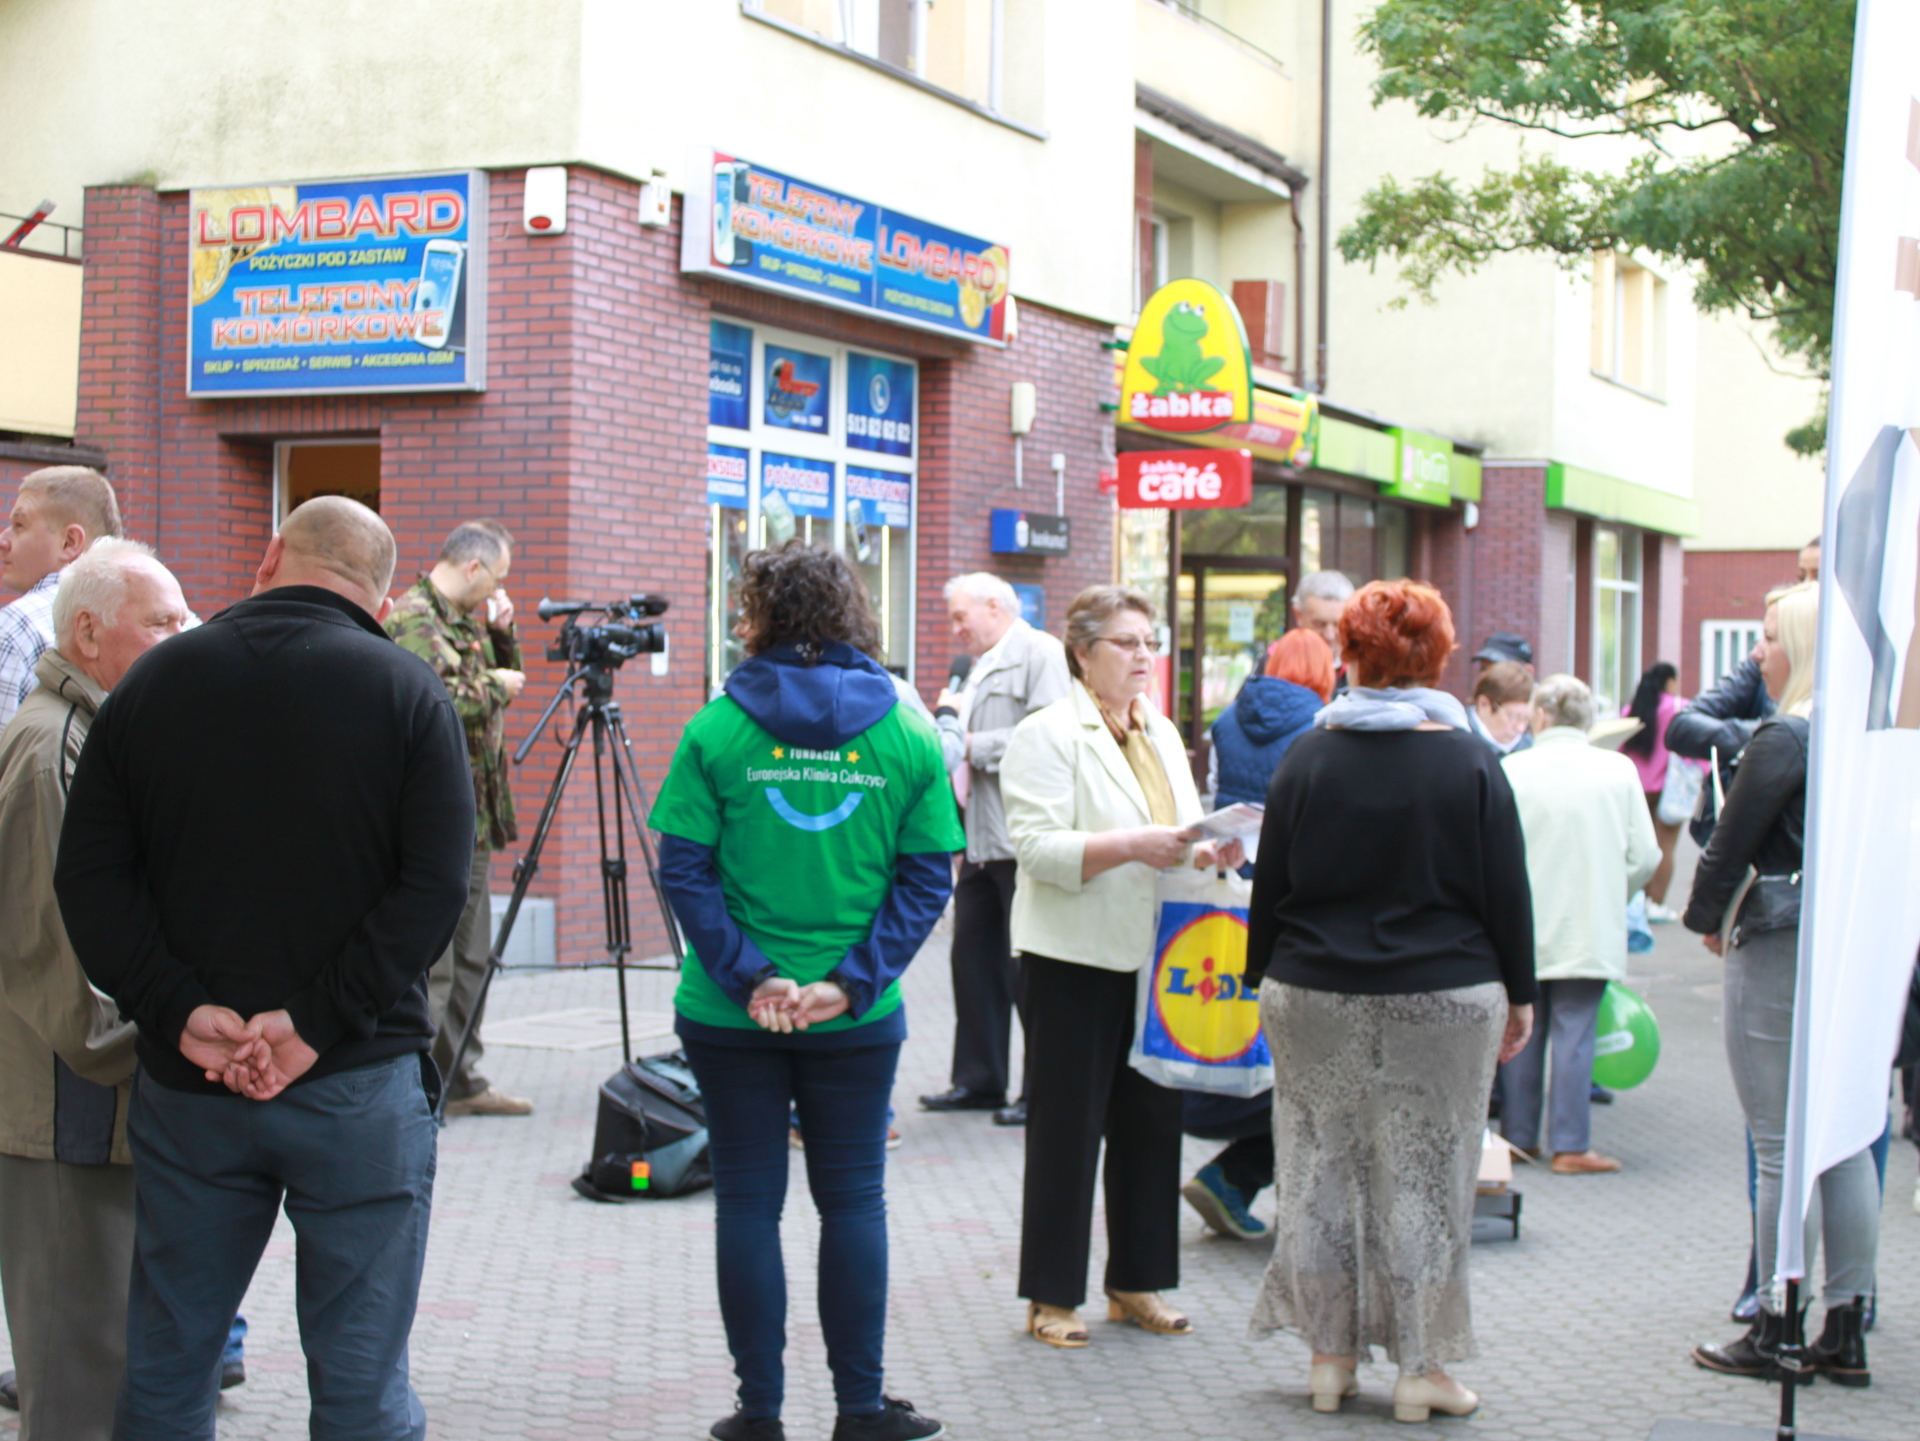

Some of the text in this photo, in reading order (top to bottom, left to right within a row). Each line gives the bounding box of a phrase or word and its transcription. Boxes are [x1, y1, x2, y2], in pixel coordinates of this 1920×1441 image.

[198, 191, 464, 246] LOMBARD
[747, 174, 862, 233] TELEFONY
[731, 204, 873, 271] KOMÓRKOWE
[250, 247, 407, 271] POŻYCZKI POD ZASTAW
[878, 226, 997, 292] LOMBARD
[235, 281, 420, 315] TELEFONY
[214, 308, 444, 347] KOMÓRKOWE
[203, 359, 234, 374] SKUP
[309, 354, 352, 370] SERWIS
[361, 352, 426, 368] AKCESORIA
[1131, 391, 1234, 418] żabka
[1138, 463, 1222, 502] café
[746, 766, 888, 789] Europejska Klinika Cukrzycy
